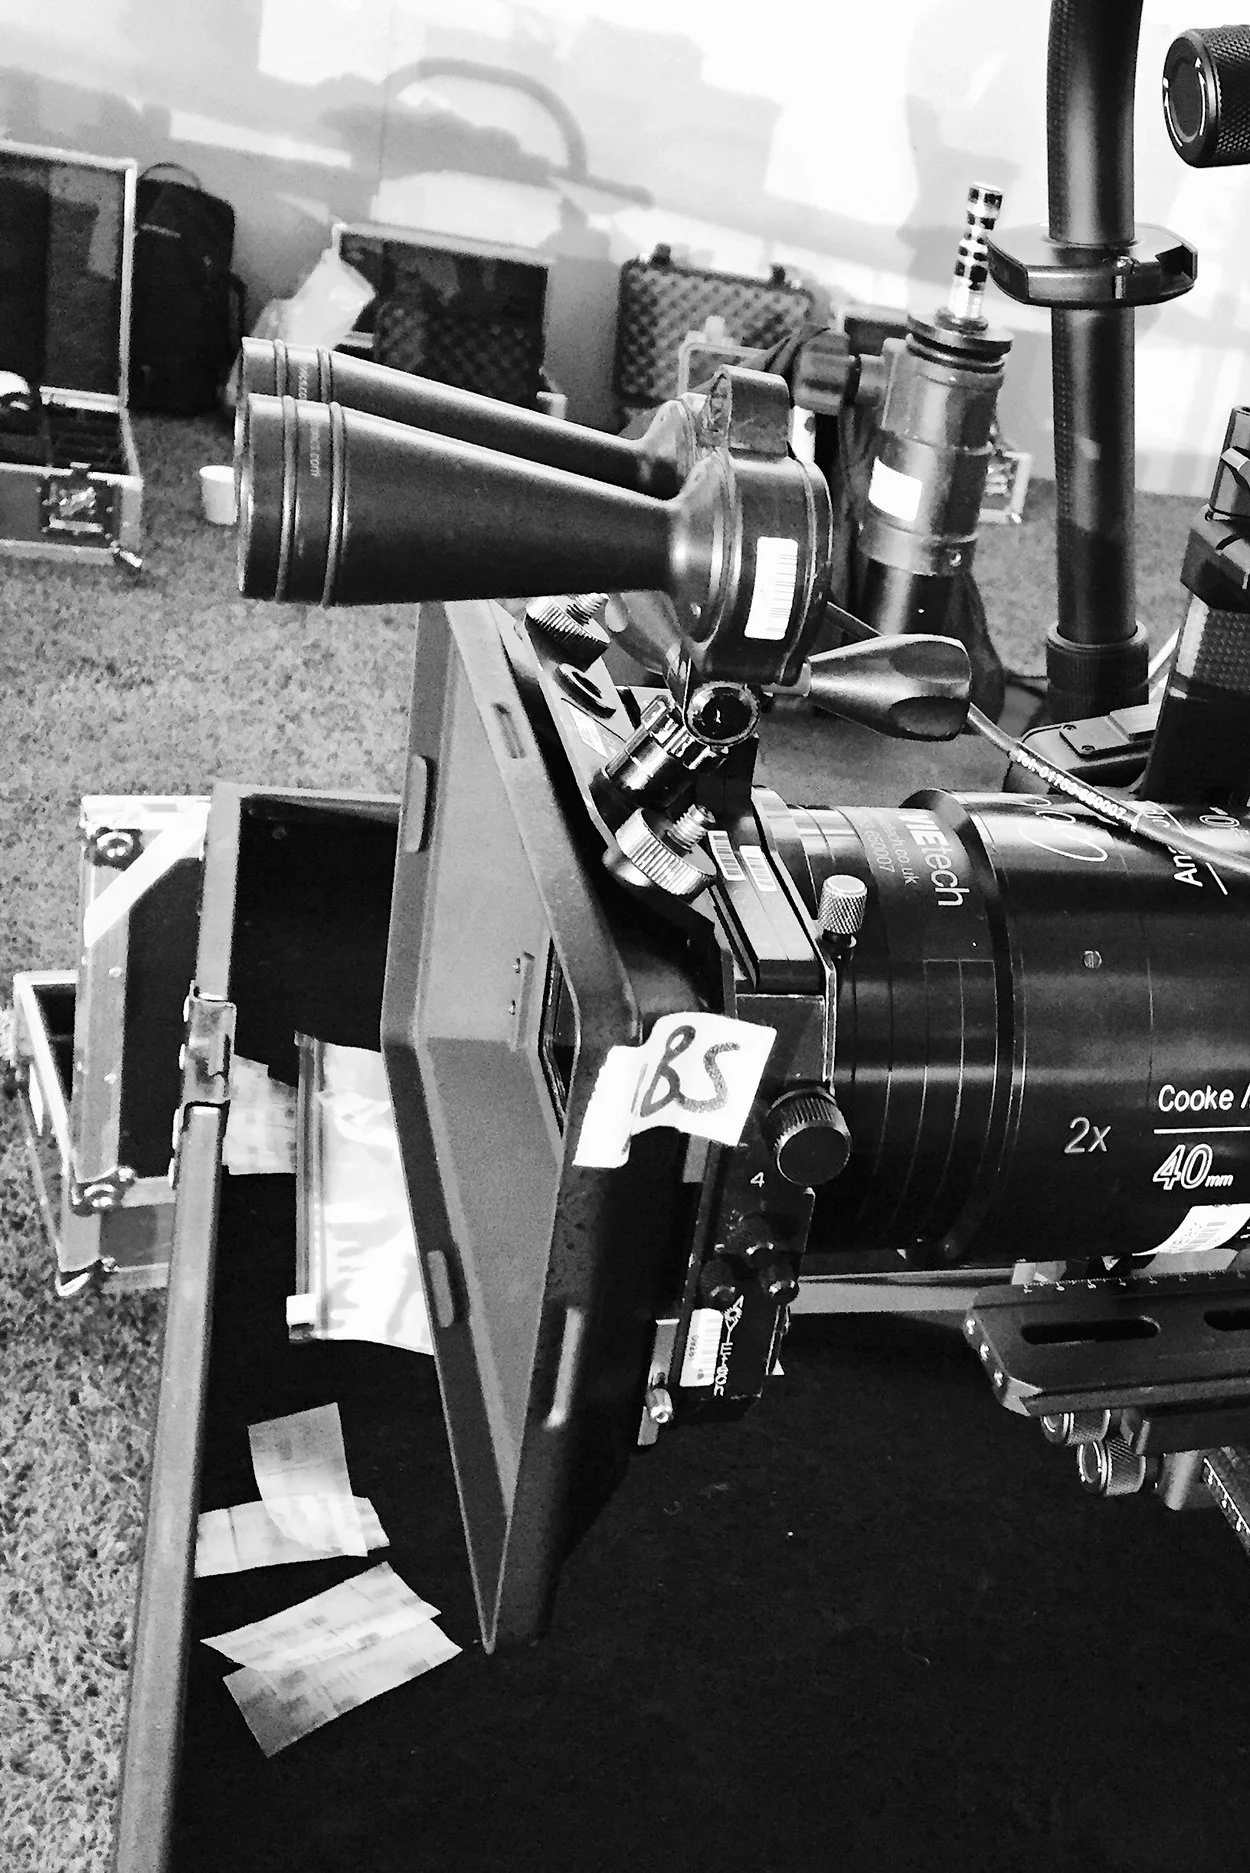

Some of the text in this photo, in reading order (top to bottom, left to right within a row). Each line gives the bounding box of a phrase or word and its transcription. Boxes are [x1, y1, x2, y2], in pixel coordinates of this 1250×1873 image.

[1157, 1084, 1235, 1113] Cooke
[1064, 1116, 1112, 1154] 2x
[750, 1171, 766, 1188] 4
